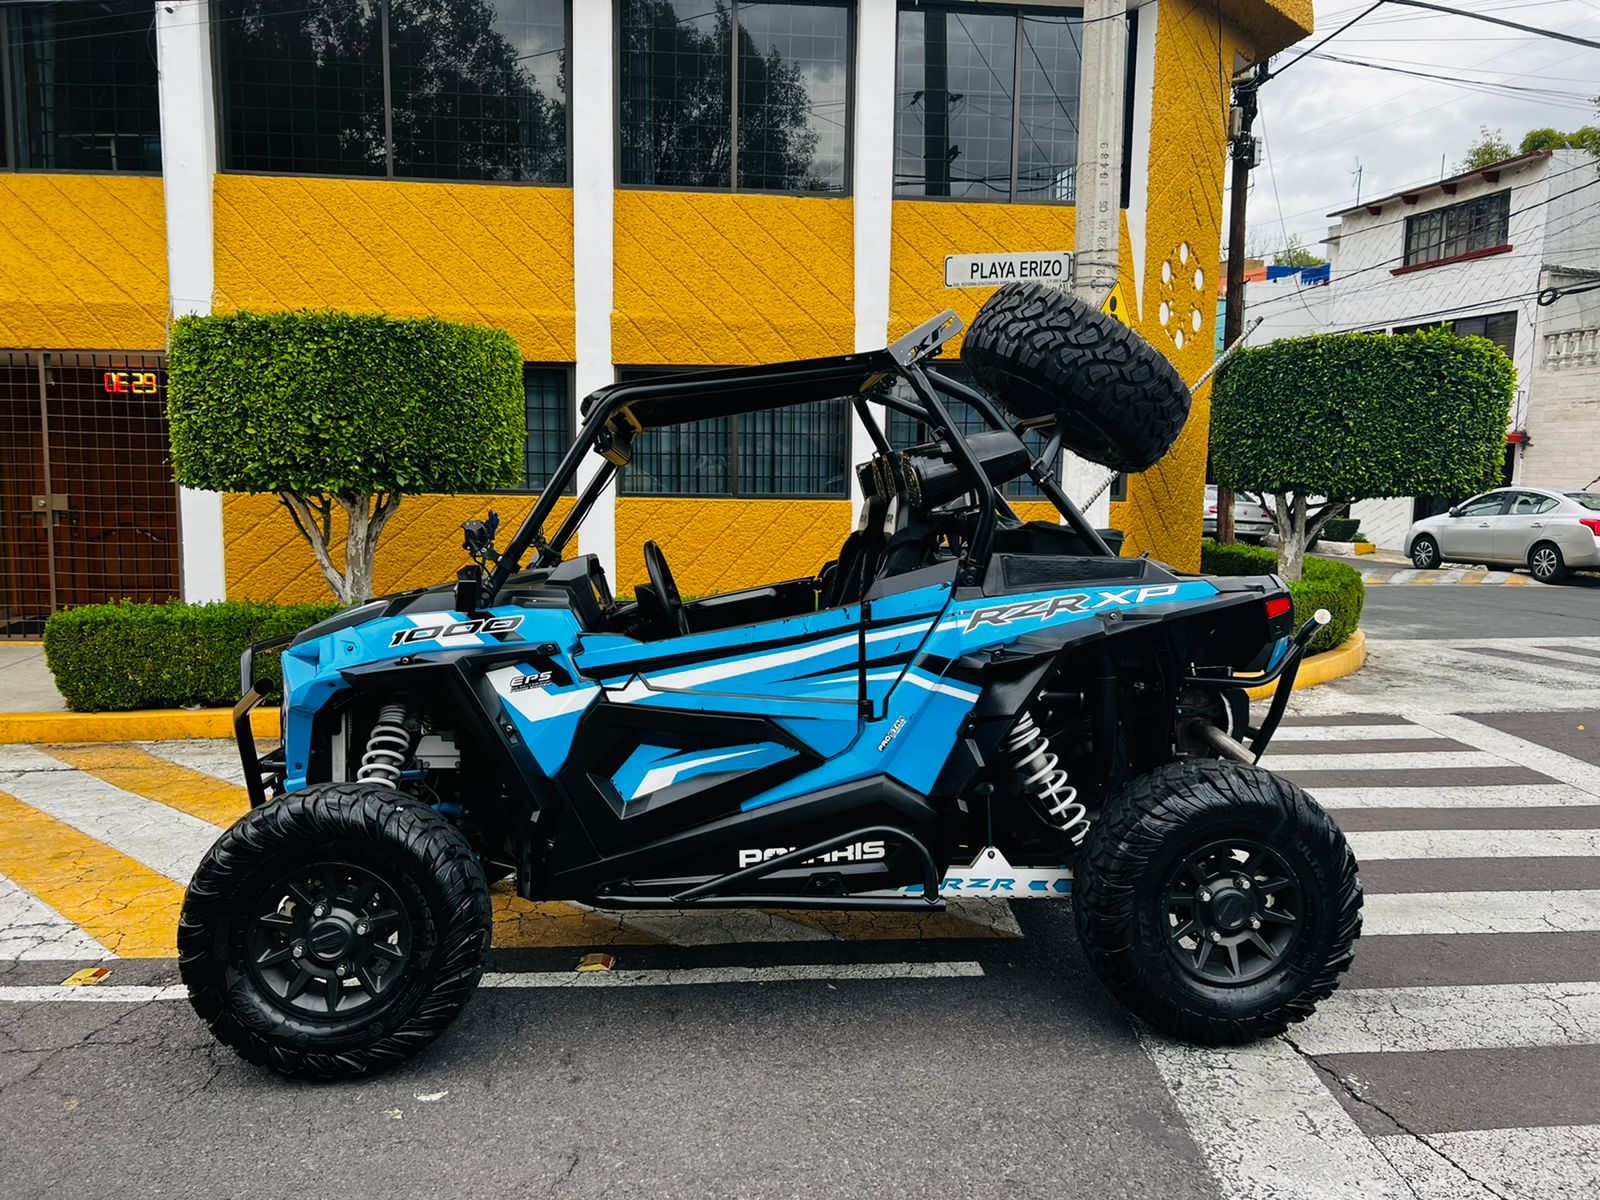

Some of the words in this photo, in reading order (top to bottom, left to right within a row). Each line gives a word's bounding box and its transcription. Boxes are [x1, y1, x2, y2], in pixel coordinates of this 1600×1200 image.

[970, 261, 1016, 280] PLAYA
[1019, 259, 1063, 278] ERIZO
[962, 593, 1091, 634] RZR
[1090, 583, 1179, 609] XP
[388, 614, 525, 648] 1000
[510, 671, 553, 687] EPS
[939, 878, 1016, 891] RZR
